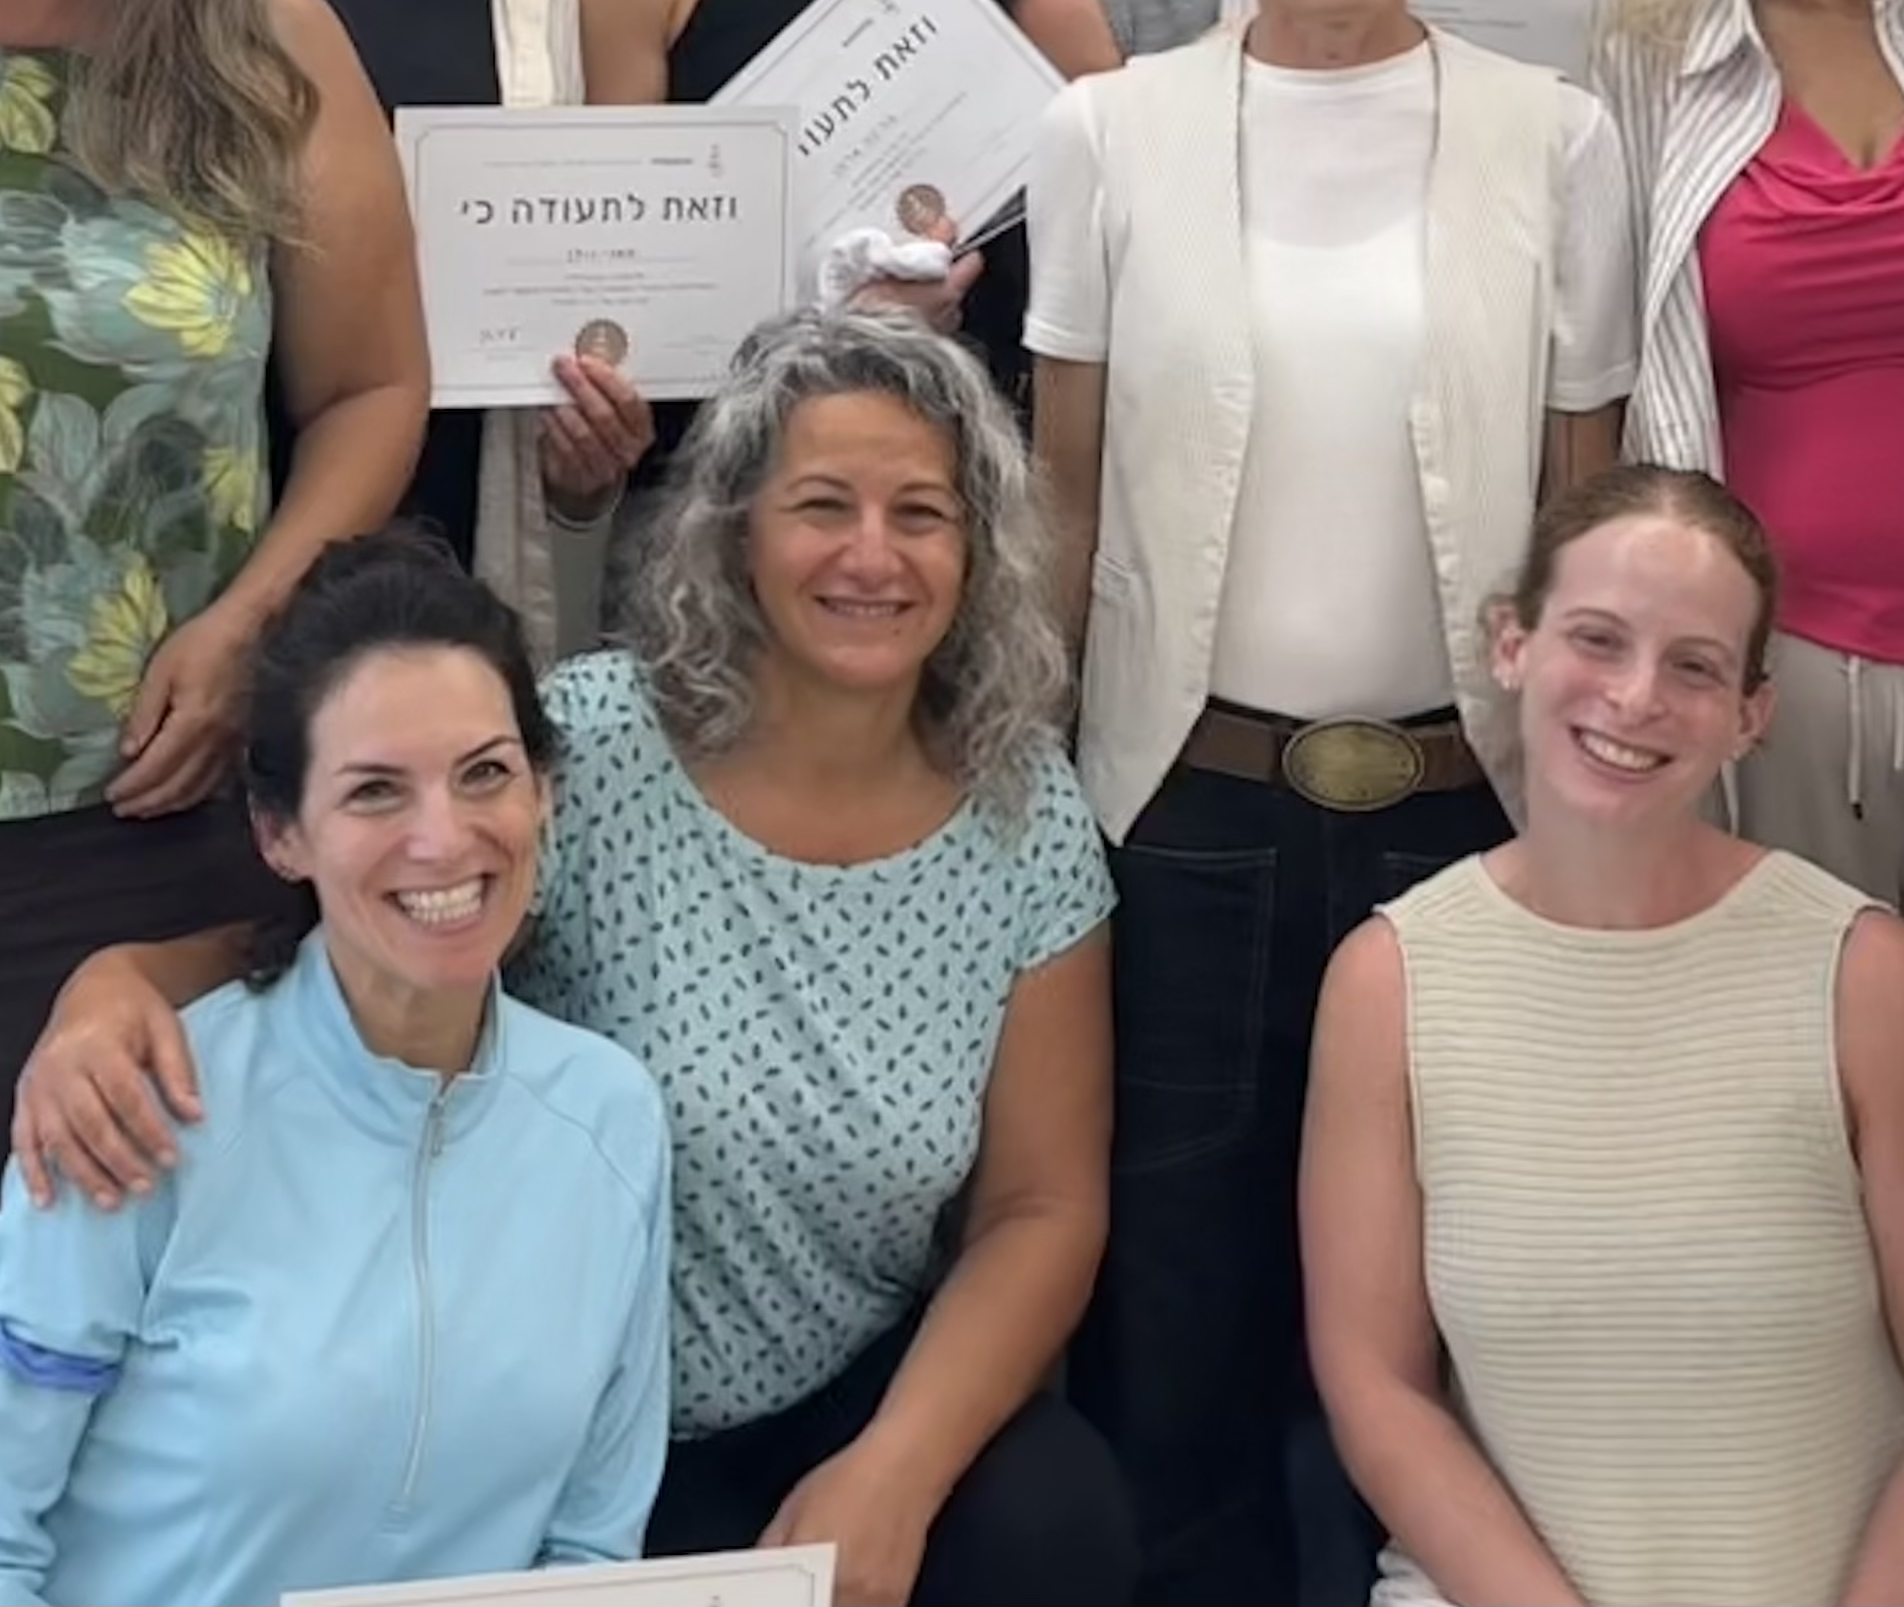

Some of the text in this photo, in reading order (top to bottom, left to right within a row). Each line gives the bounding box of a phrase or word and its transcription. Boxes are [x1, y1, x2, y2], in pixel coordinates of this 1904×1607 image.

[872, 15, 939, 82] וזאת
[796, 77, 872, 157] לתעו
[459, 193, 739, 225] וזאת לתעודה כי
